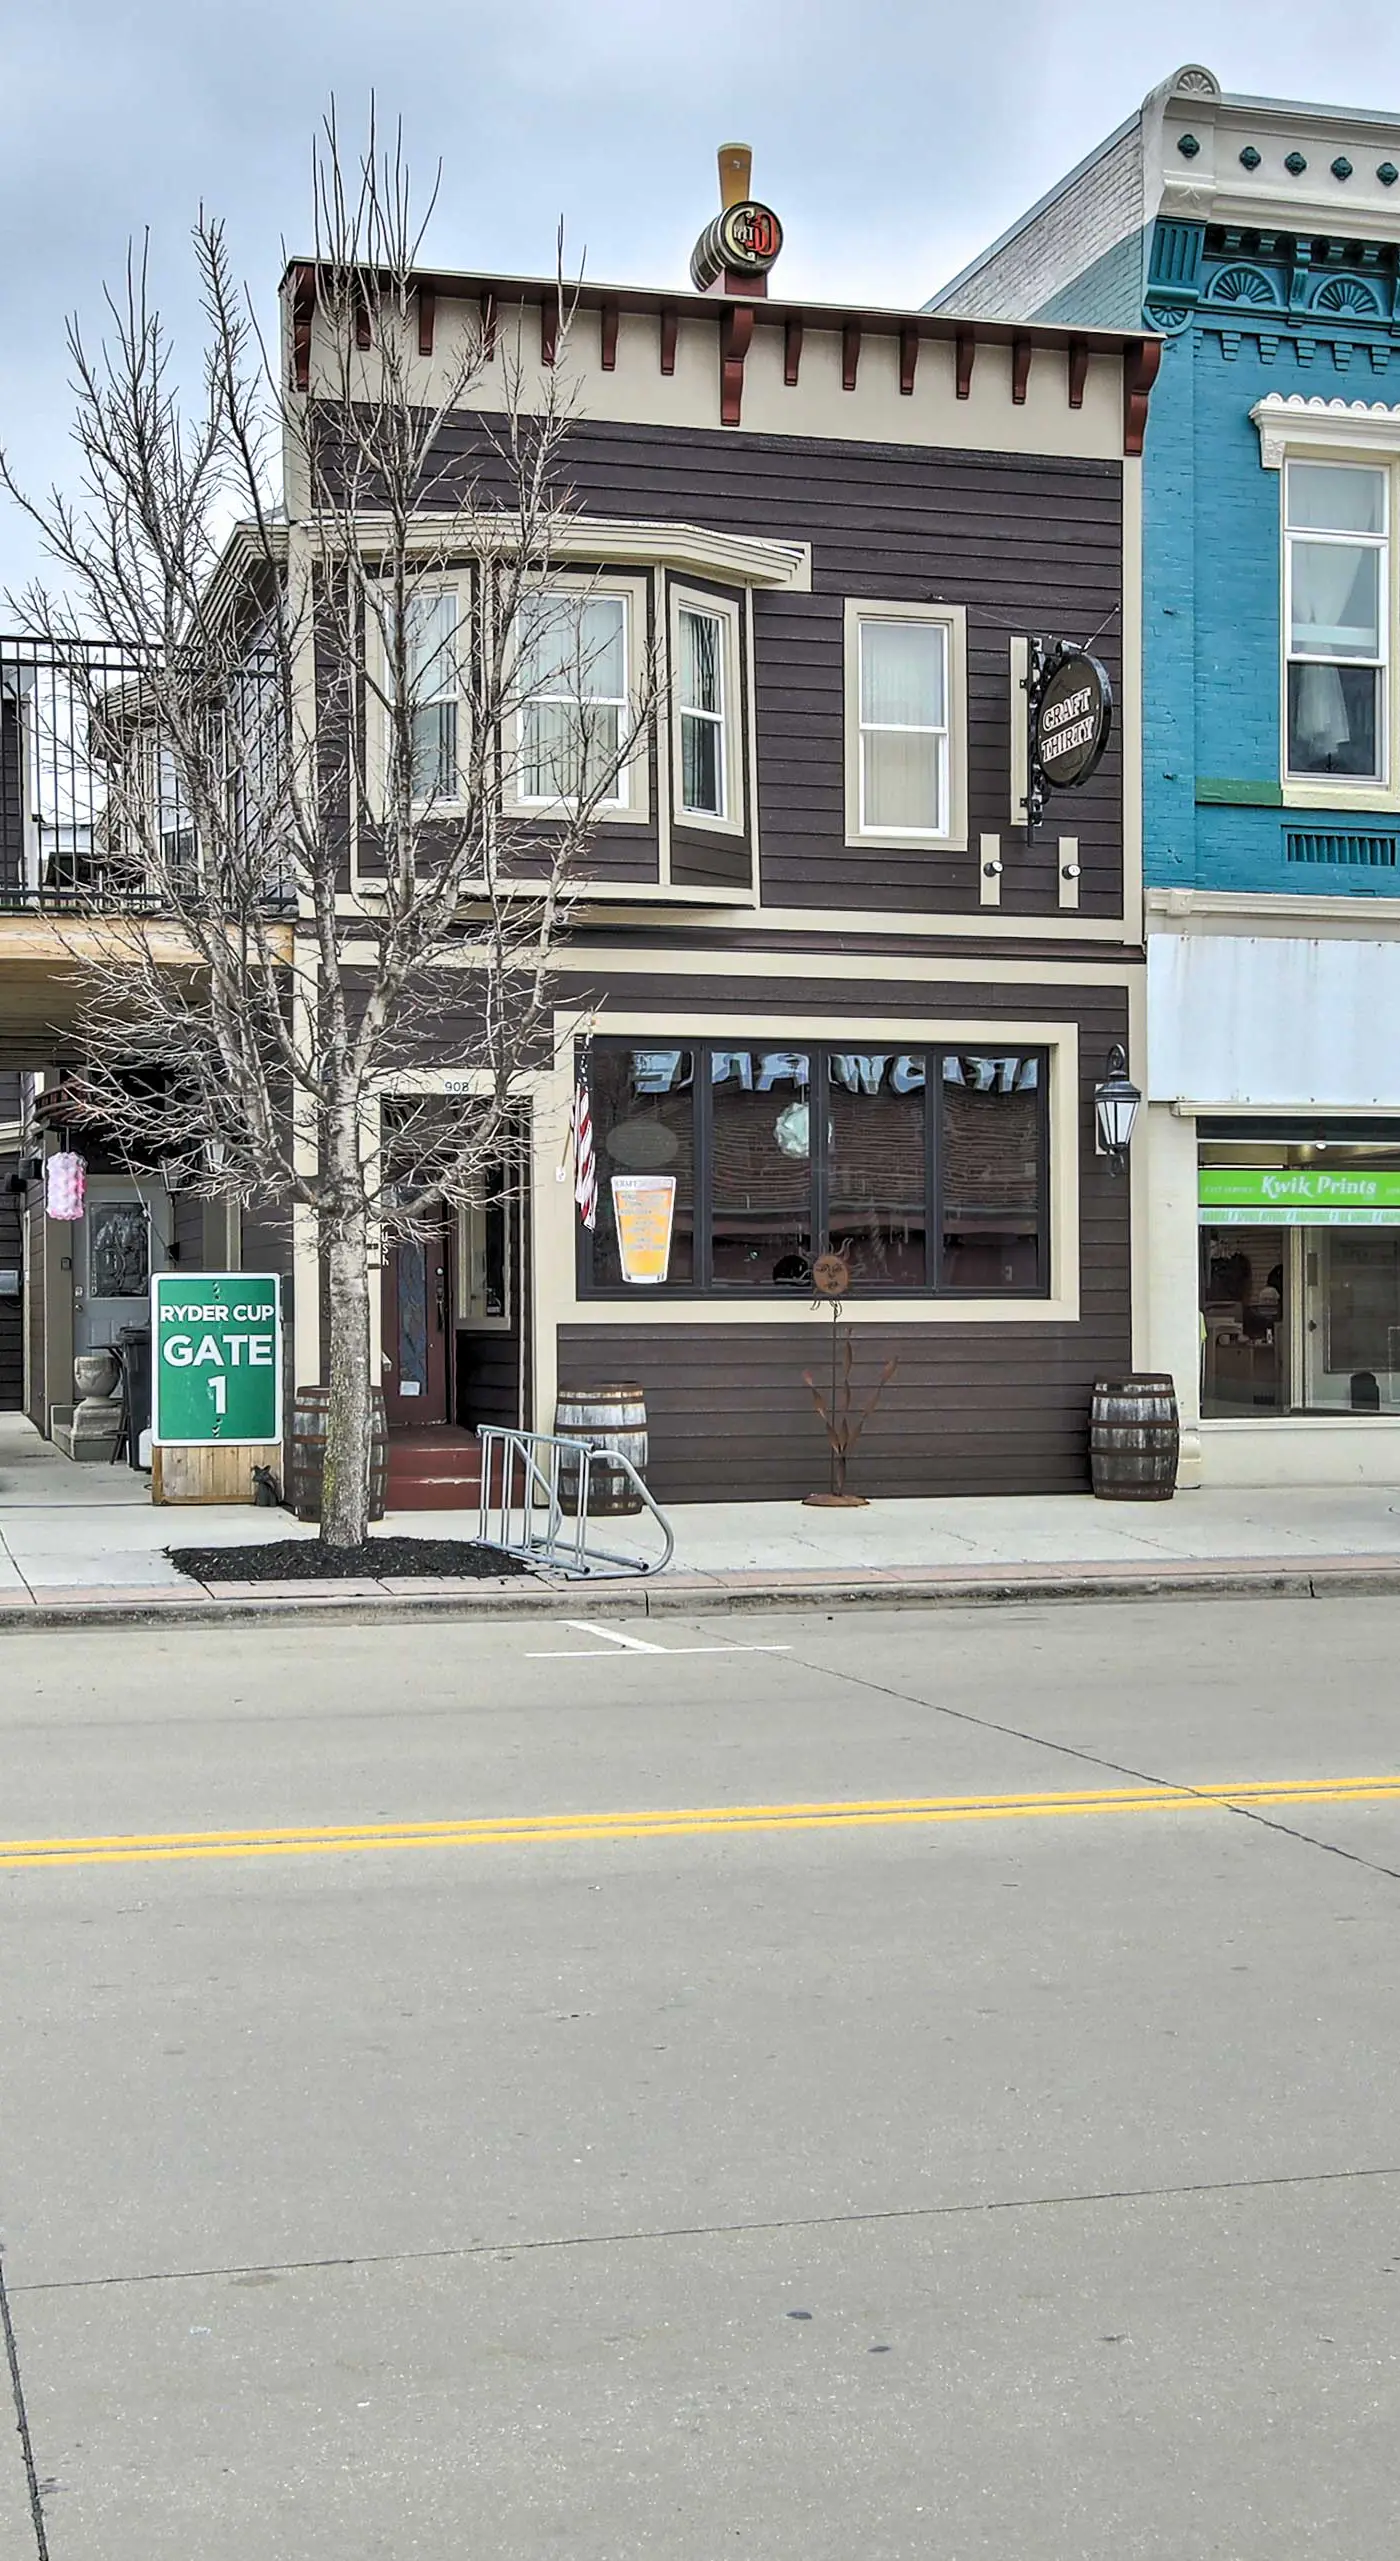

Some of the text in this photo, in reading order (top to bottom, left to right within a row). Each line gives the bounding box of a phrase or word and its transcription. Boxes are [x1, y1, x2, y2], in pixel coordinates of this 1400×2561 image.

[1042, 686, 1091, 732] CRAFT
[1041, 715, 1095, 763] THIRTY
[445, 1081, 469, 1092] 908
[1260, 1175, 1316, 1199] Kwik
[1317, 1176, 1377, 1195] Prints
[160, 1305, 275, 1322] RYDER CUP
[163, 1334, 273, 1367] GATE
[207, 1375, 227, 1414] 1
